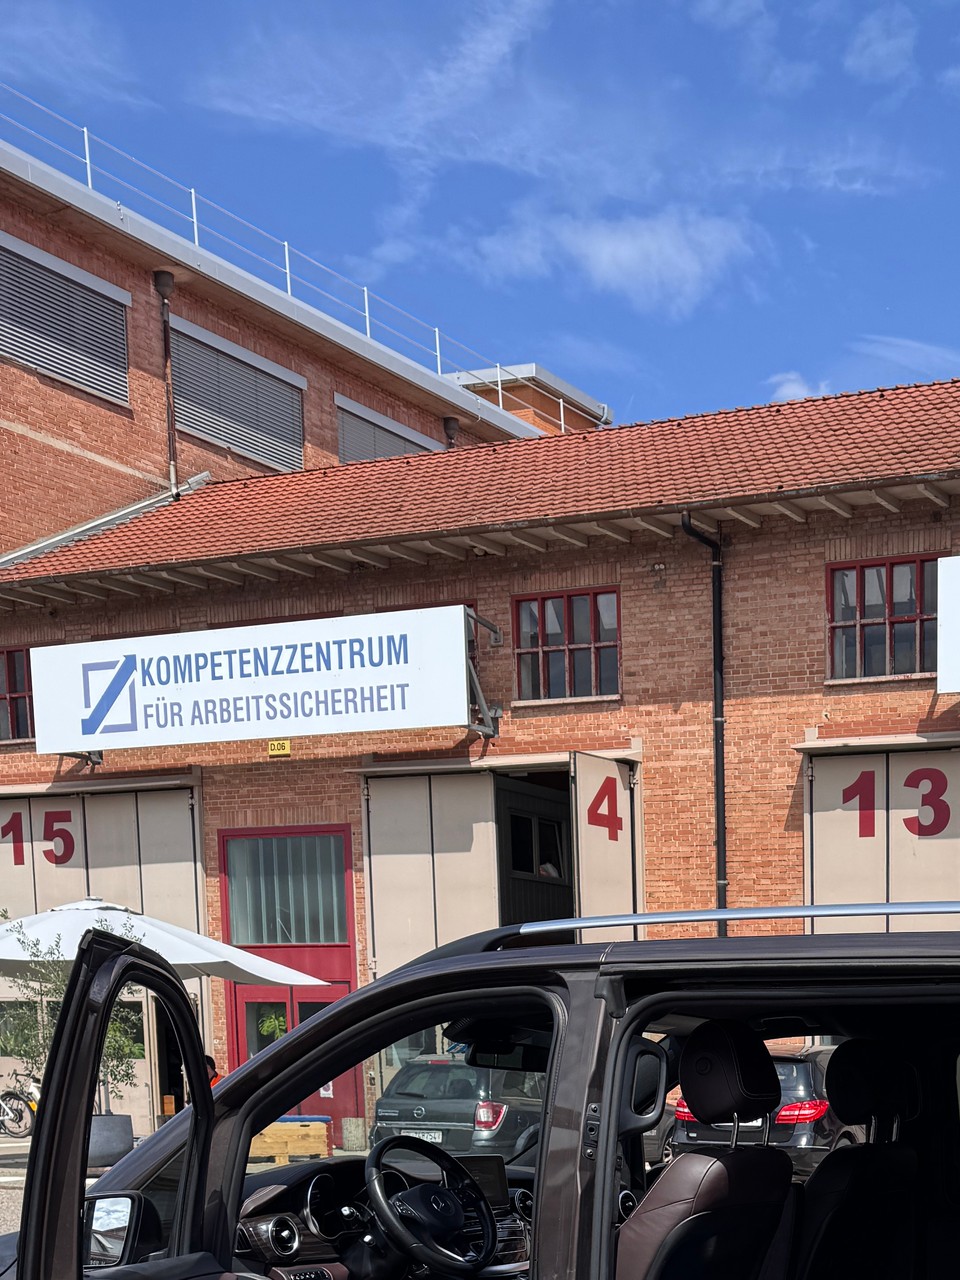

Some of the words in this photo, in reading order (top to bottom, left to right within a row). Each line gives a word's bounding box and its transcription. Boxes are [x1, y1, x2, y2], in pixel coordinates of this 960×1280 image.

[141, 633, 409, 688] KOMPETENZZENTRUM
[143, 697, 184, 729] FÜR
[191, 683, 409, 726] ARBEITSSICHERHEIT
[587, 776, 623, 842] 4
[842, 767, 951, 838] 13
[0, 810, 75, 866] 15
